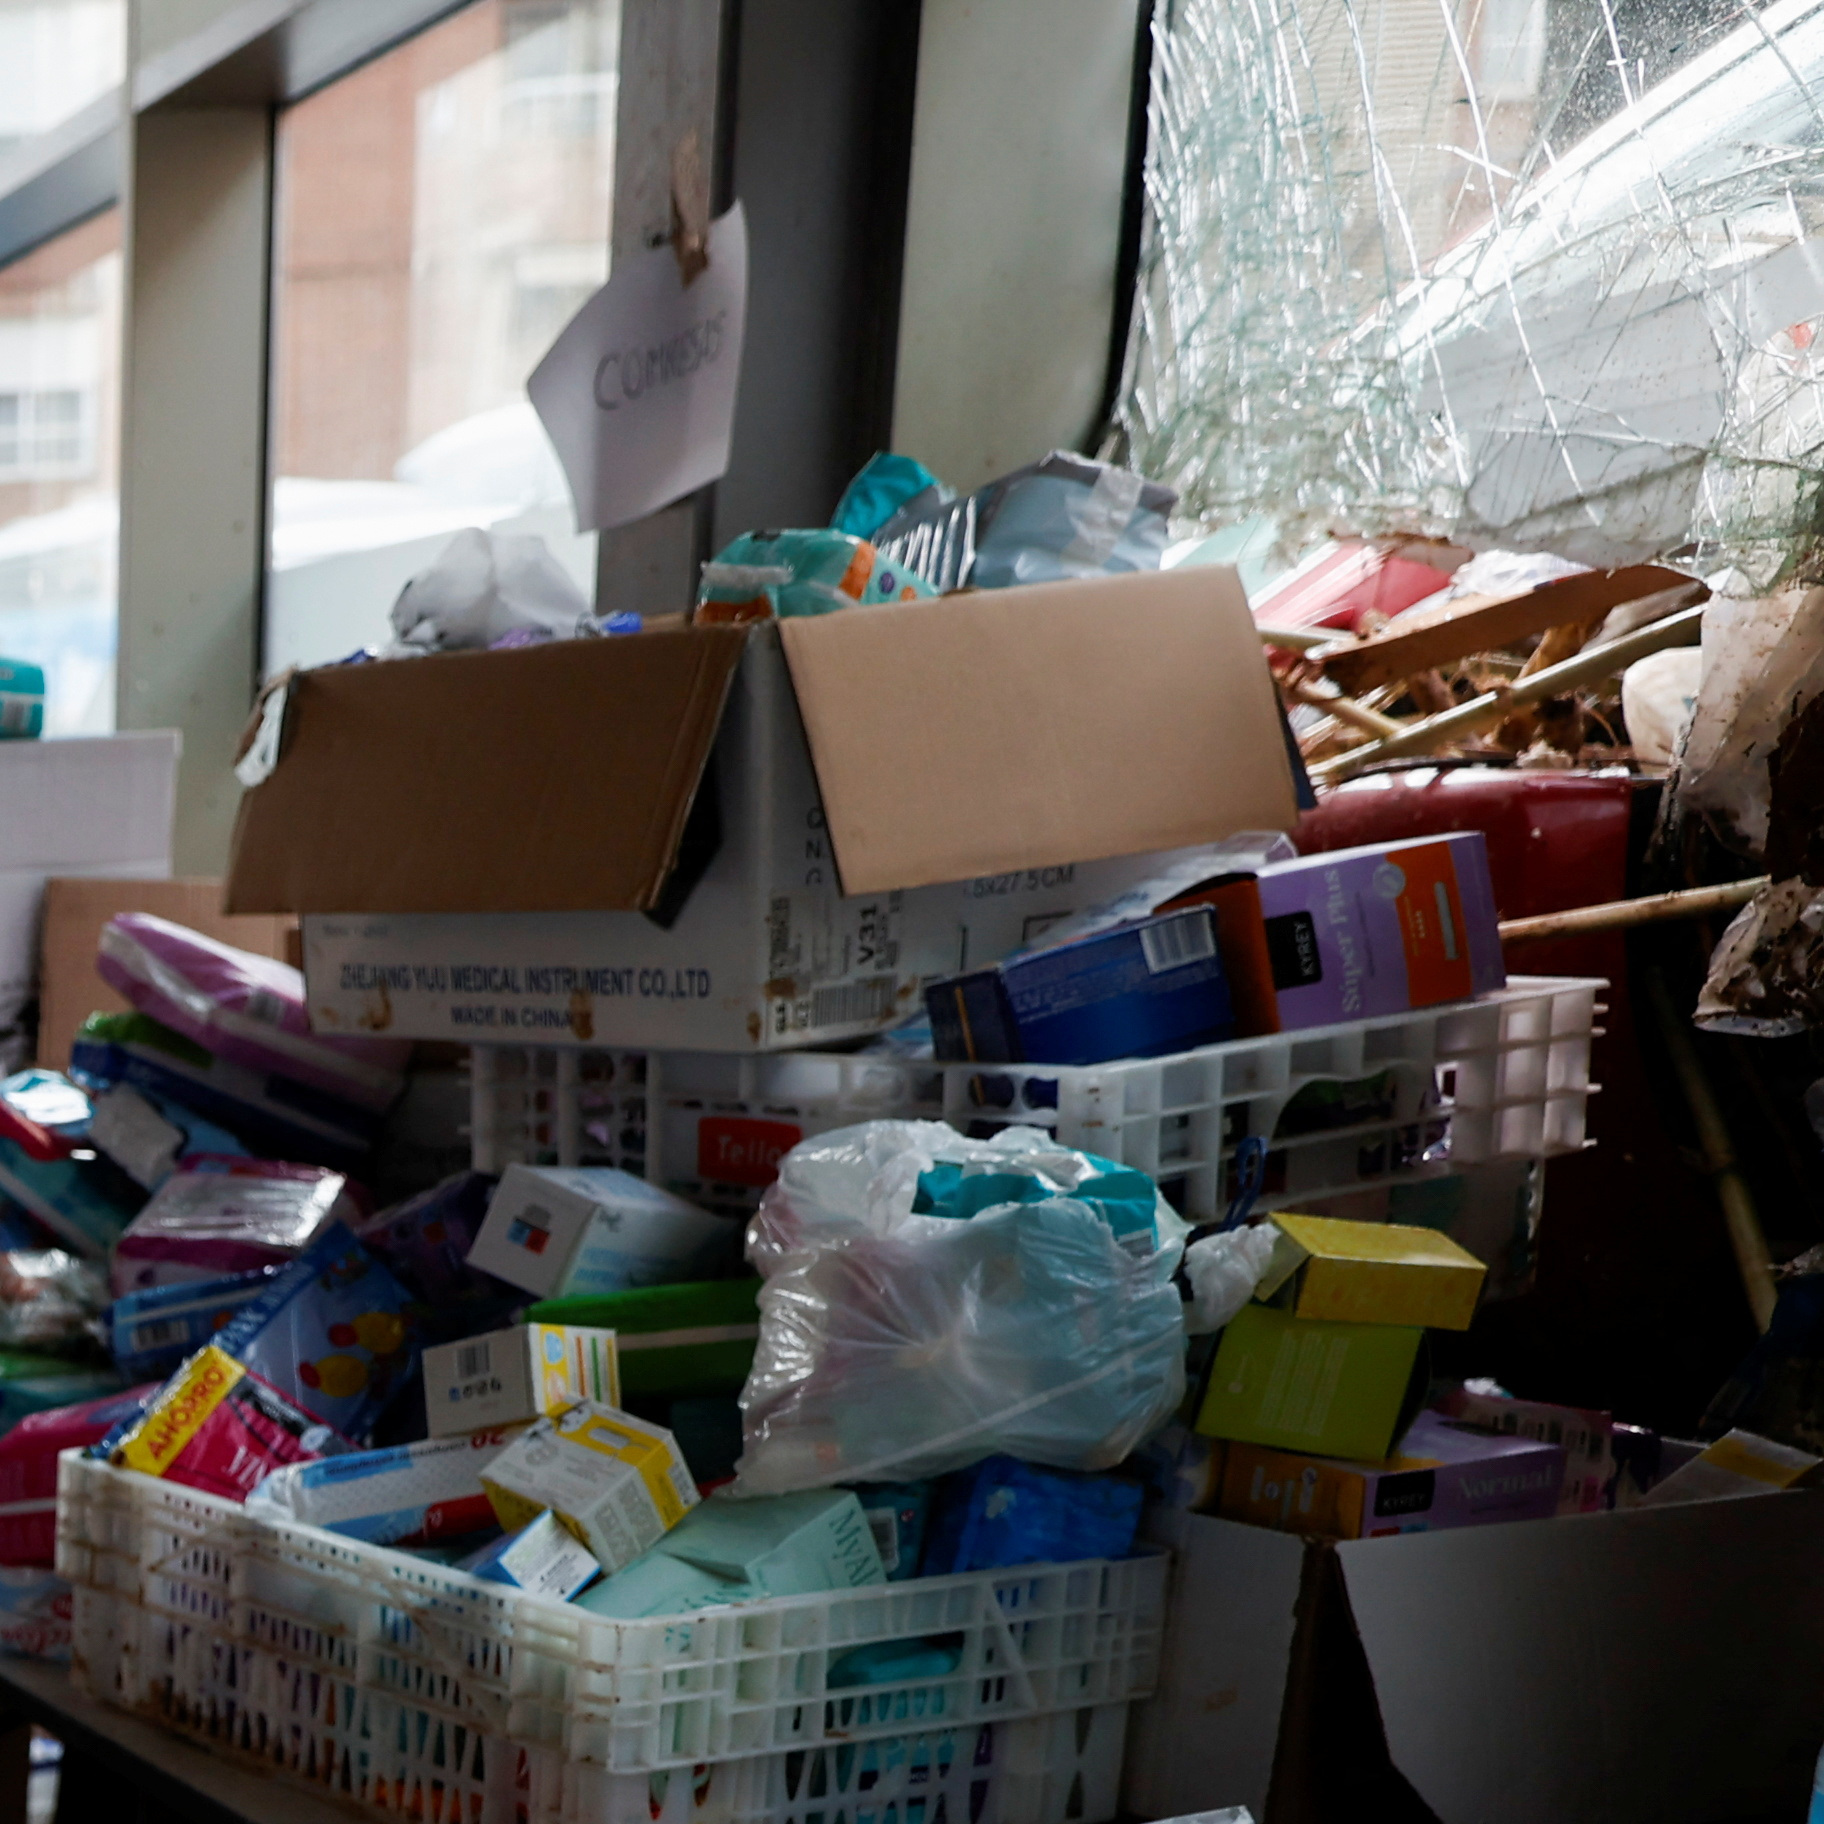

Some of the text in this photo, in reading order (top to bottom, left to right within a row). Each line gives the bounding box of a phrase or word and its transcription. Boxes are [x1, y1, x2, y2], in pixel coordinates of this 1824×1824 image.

[856, 904, 876, 965] V31
[451, 966, 521, 994] MEDICAL
[524, 968, 634, 997] INSTRUMENT
[500, 1006, 516, 1027] IN
[1458, 1464, 1553, 1499] Normal
